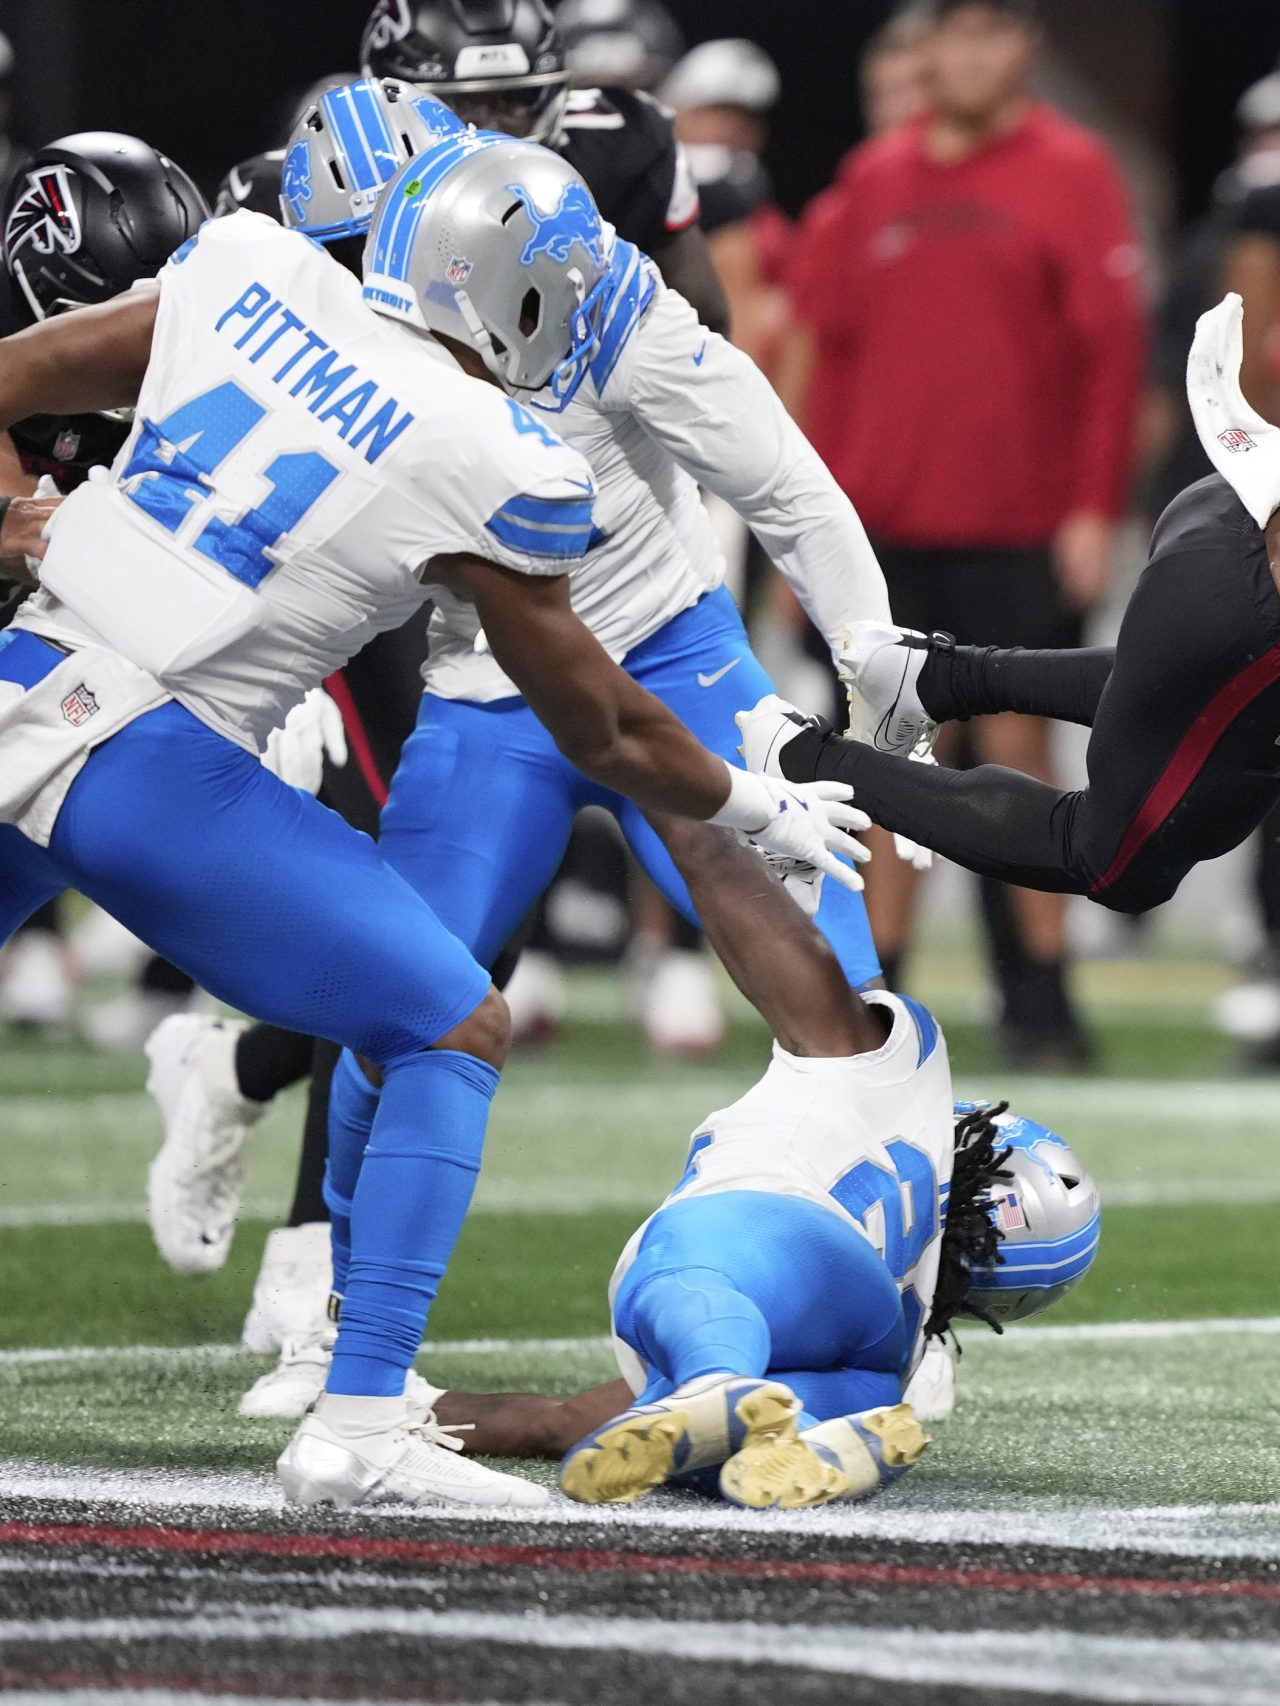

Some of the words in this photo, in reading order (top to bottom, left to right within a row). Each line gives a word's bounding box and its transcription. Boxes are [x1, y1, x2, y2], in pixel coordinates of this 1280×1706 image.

[214, 281, 415, 465] PITTMAN
[120, 375, 346, 593] 41
[64, 694, 87, 724] NFL
